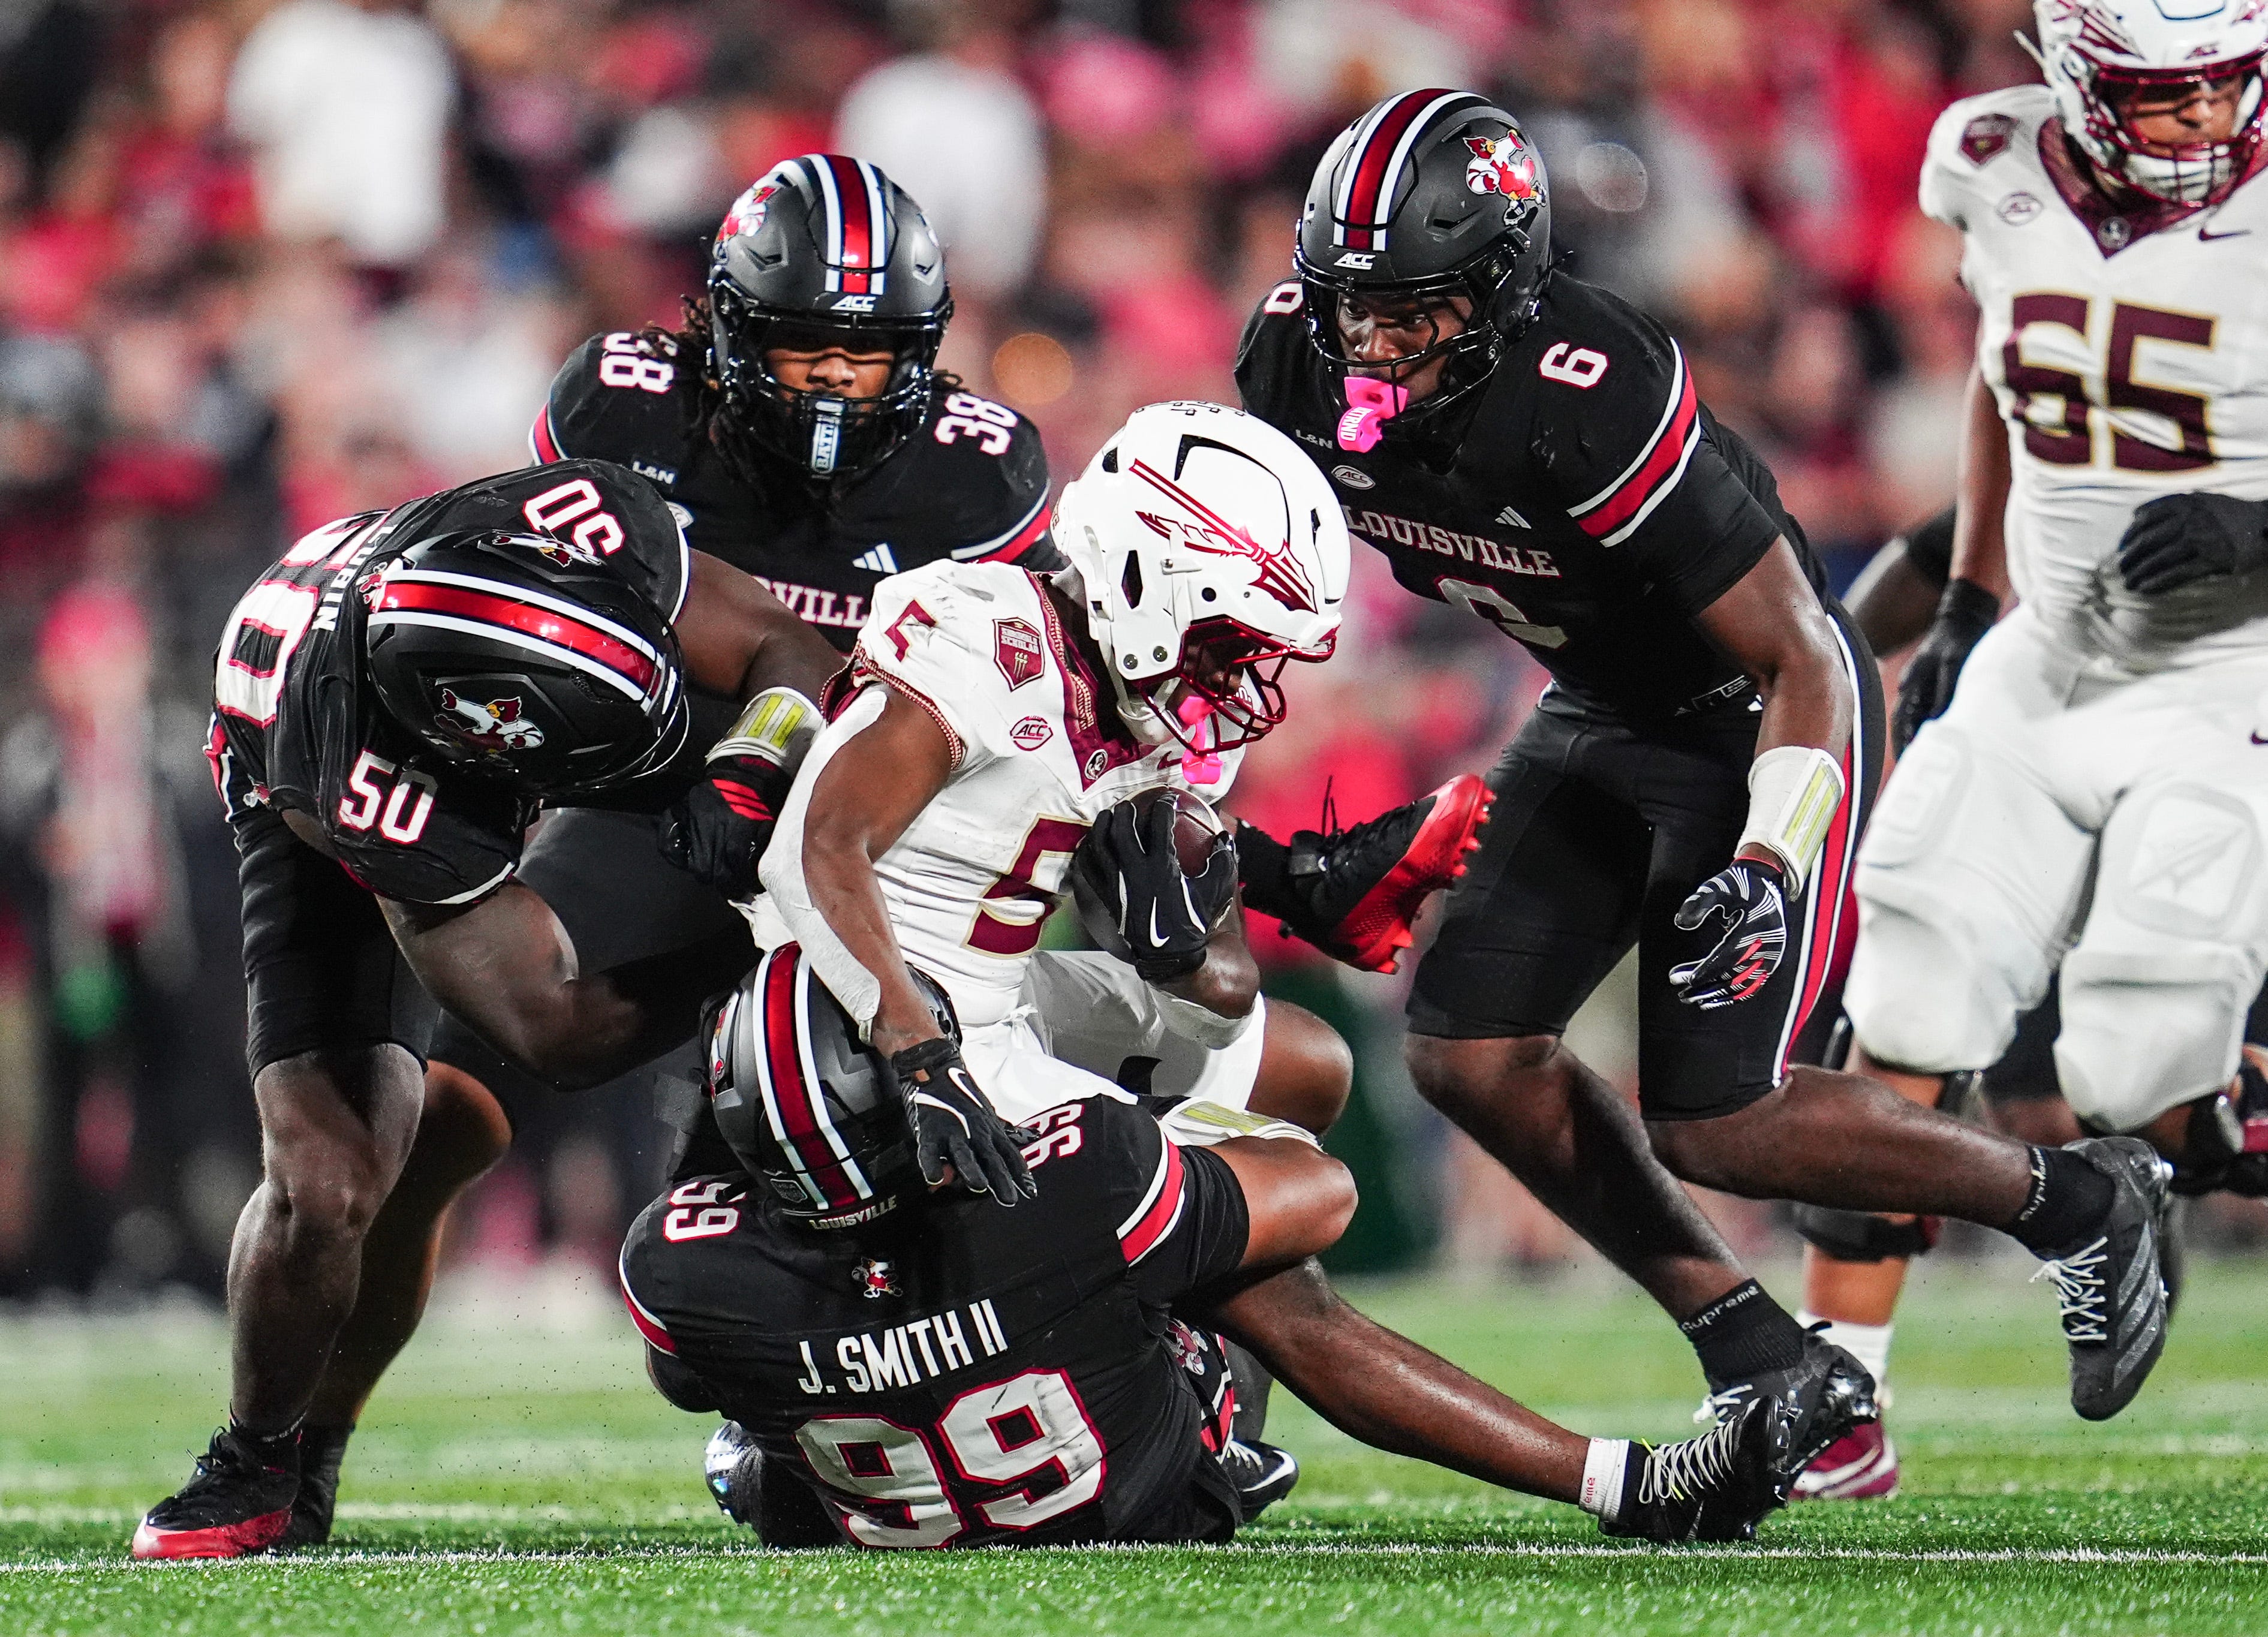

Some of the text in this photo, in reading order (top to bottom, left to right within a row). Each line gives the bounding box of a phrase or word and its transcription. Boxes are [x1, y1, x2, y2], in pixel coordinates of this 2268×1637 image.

[1334, 252, 1376, 270] ACC
[830, 295, 876, 311] ACC
[1539, 341, 1610, 390] 6
[2002, 290, 2219, 473] 65
[933, 392, 1019, 456] 38
[1296, 429, 1333, 449] L&N
[632, 461, 675, 485] L&N
[1340, 471, 1368, 483] ACC
[1341, 504, 1562, 577] LOUISVILLE
[1014, 724, 1048, 739] ACC
[338, 748, 438, 844] 50
[961, 813, 1093, 959] 5
[809, 1195, 897, 1230] LOUISVILLE
[1681, 1285, 1759, 1331] Supreme
[798, 1299, 1008, 1394] J. SMITH II
[795, 1367, 1108, 1549] 99
